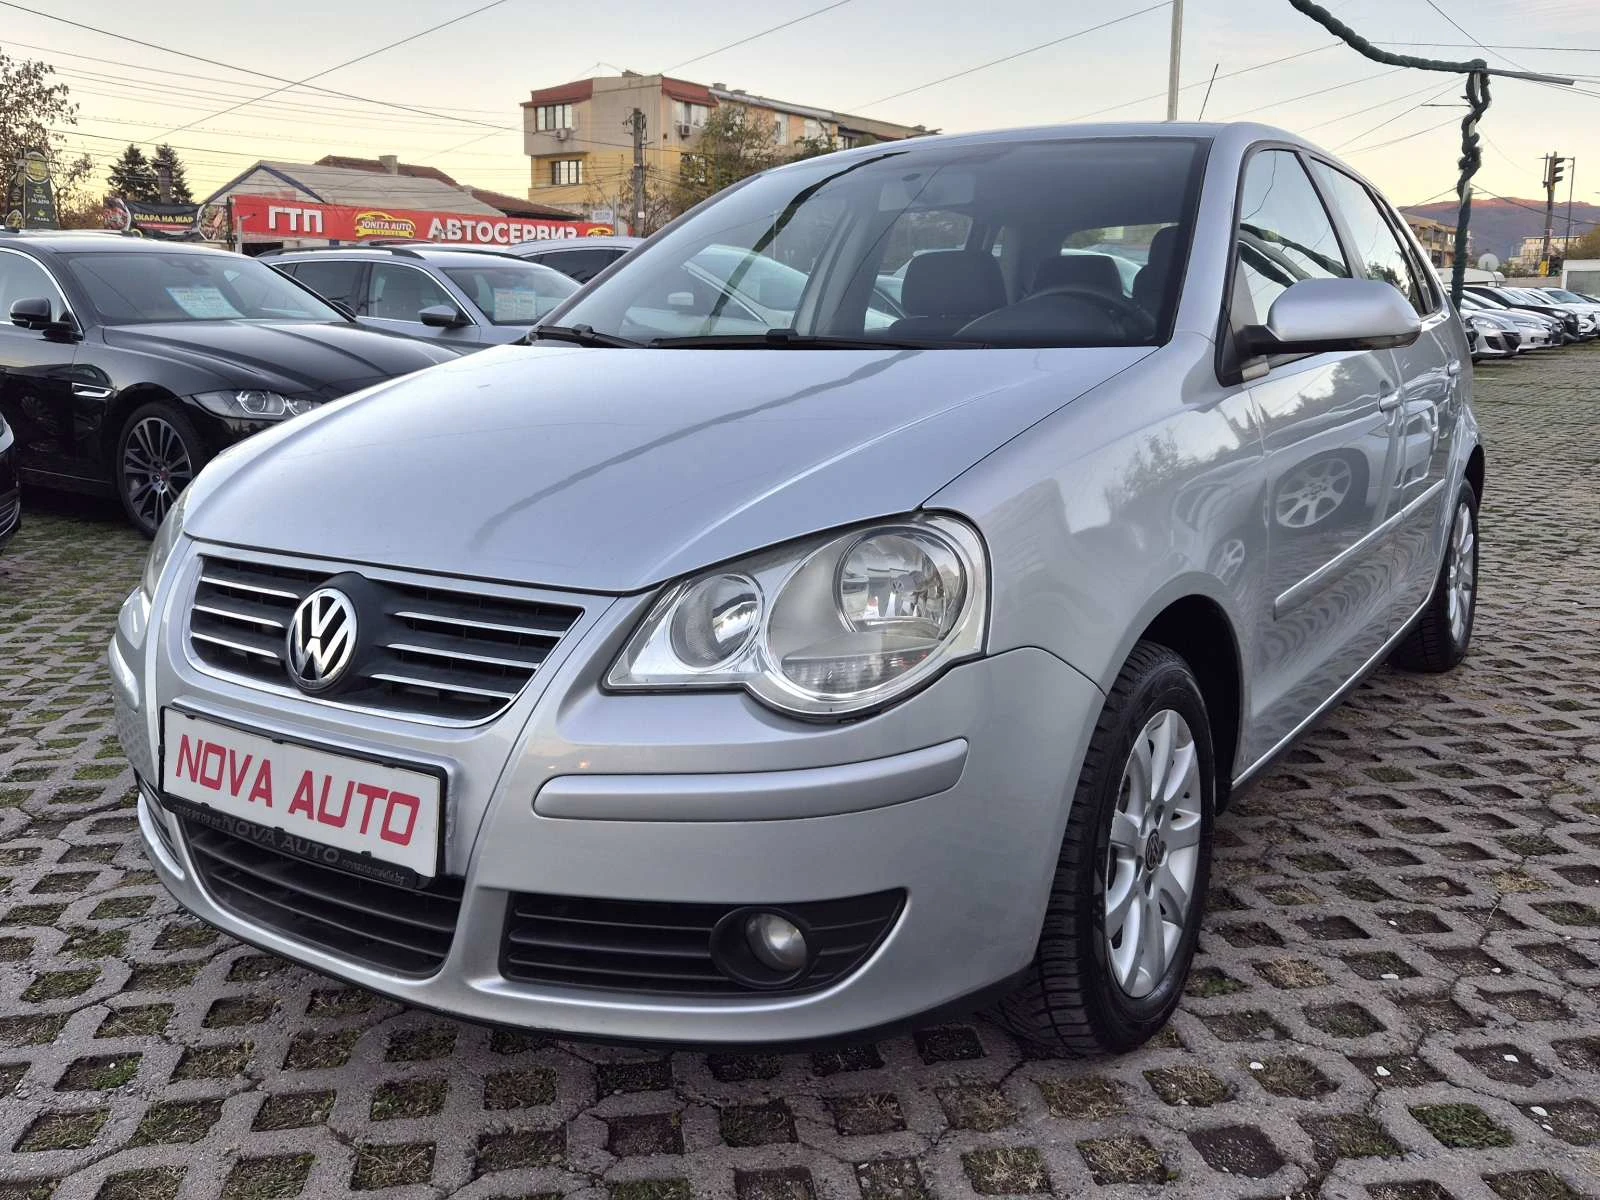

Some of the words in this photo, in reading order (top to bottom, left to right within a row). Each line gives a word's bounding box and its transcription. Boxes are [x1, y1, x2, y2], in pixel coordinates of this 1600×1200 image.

[133, 213, 161, 222] СКАРА
[175, 216, 194, 224] ЖАР
[268, 205, 323, 233] ГТП
[390, 222, 412, 232] AUTO
[427, 218, 578, 244] АВТОСЕРВИЗ
[175, 733, 273, 808] NOVA
[287, 769, 421, 847] AUTO
[220, 814, 277, 847] NOVA
[280, 835, 340, 863] AUTO
